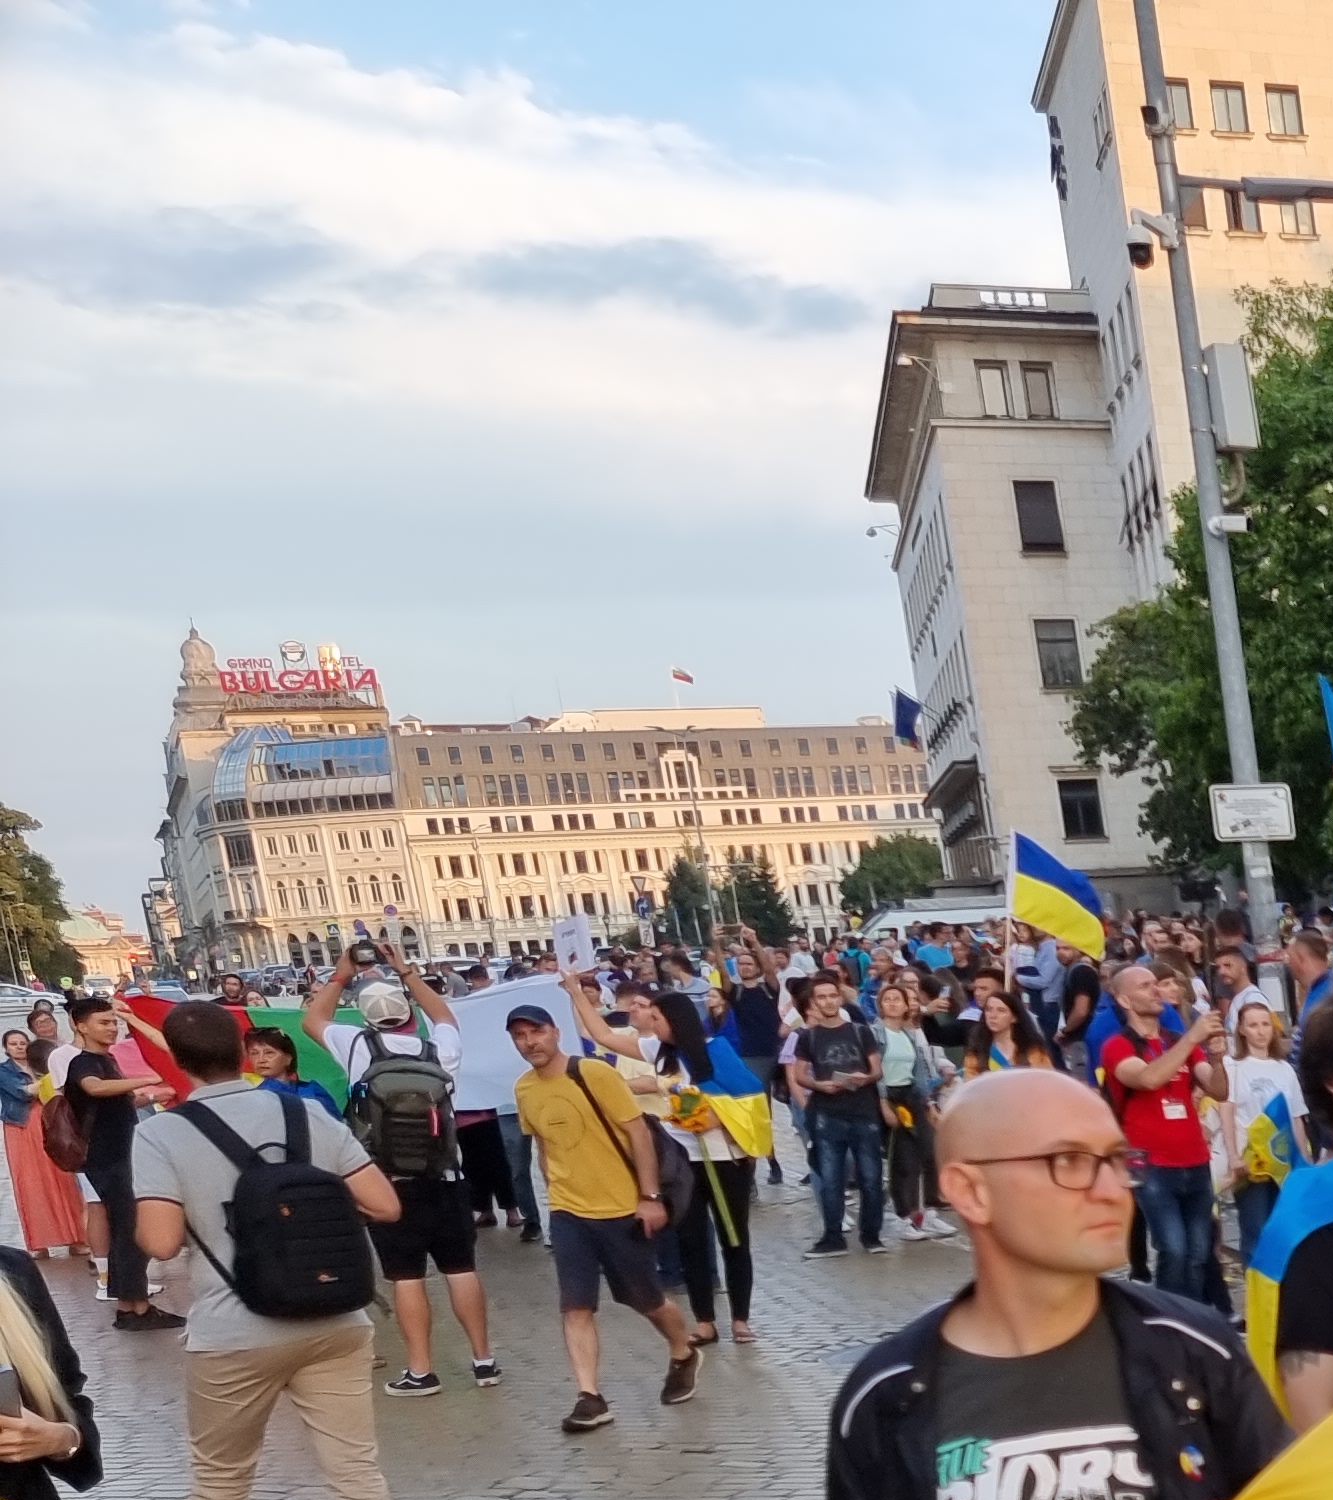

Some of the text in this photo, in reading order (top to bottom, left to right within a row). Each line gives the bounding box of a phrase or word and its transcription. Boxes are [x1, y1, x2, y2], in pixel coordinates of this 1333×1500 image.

[226, 656, 363, 669] GRAND HTEL
[218, 668, 379, 693] BULGARIA
